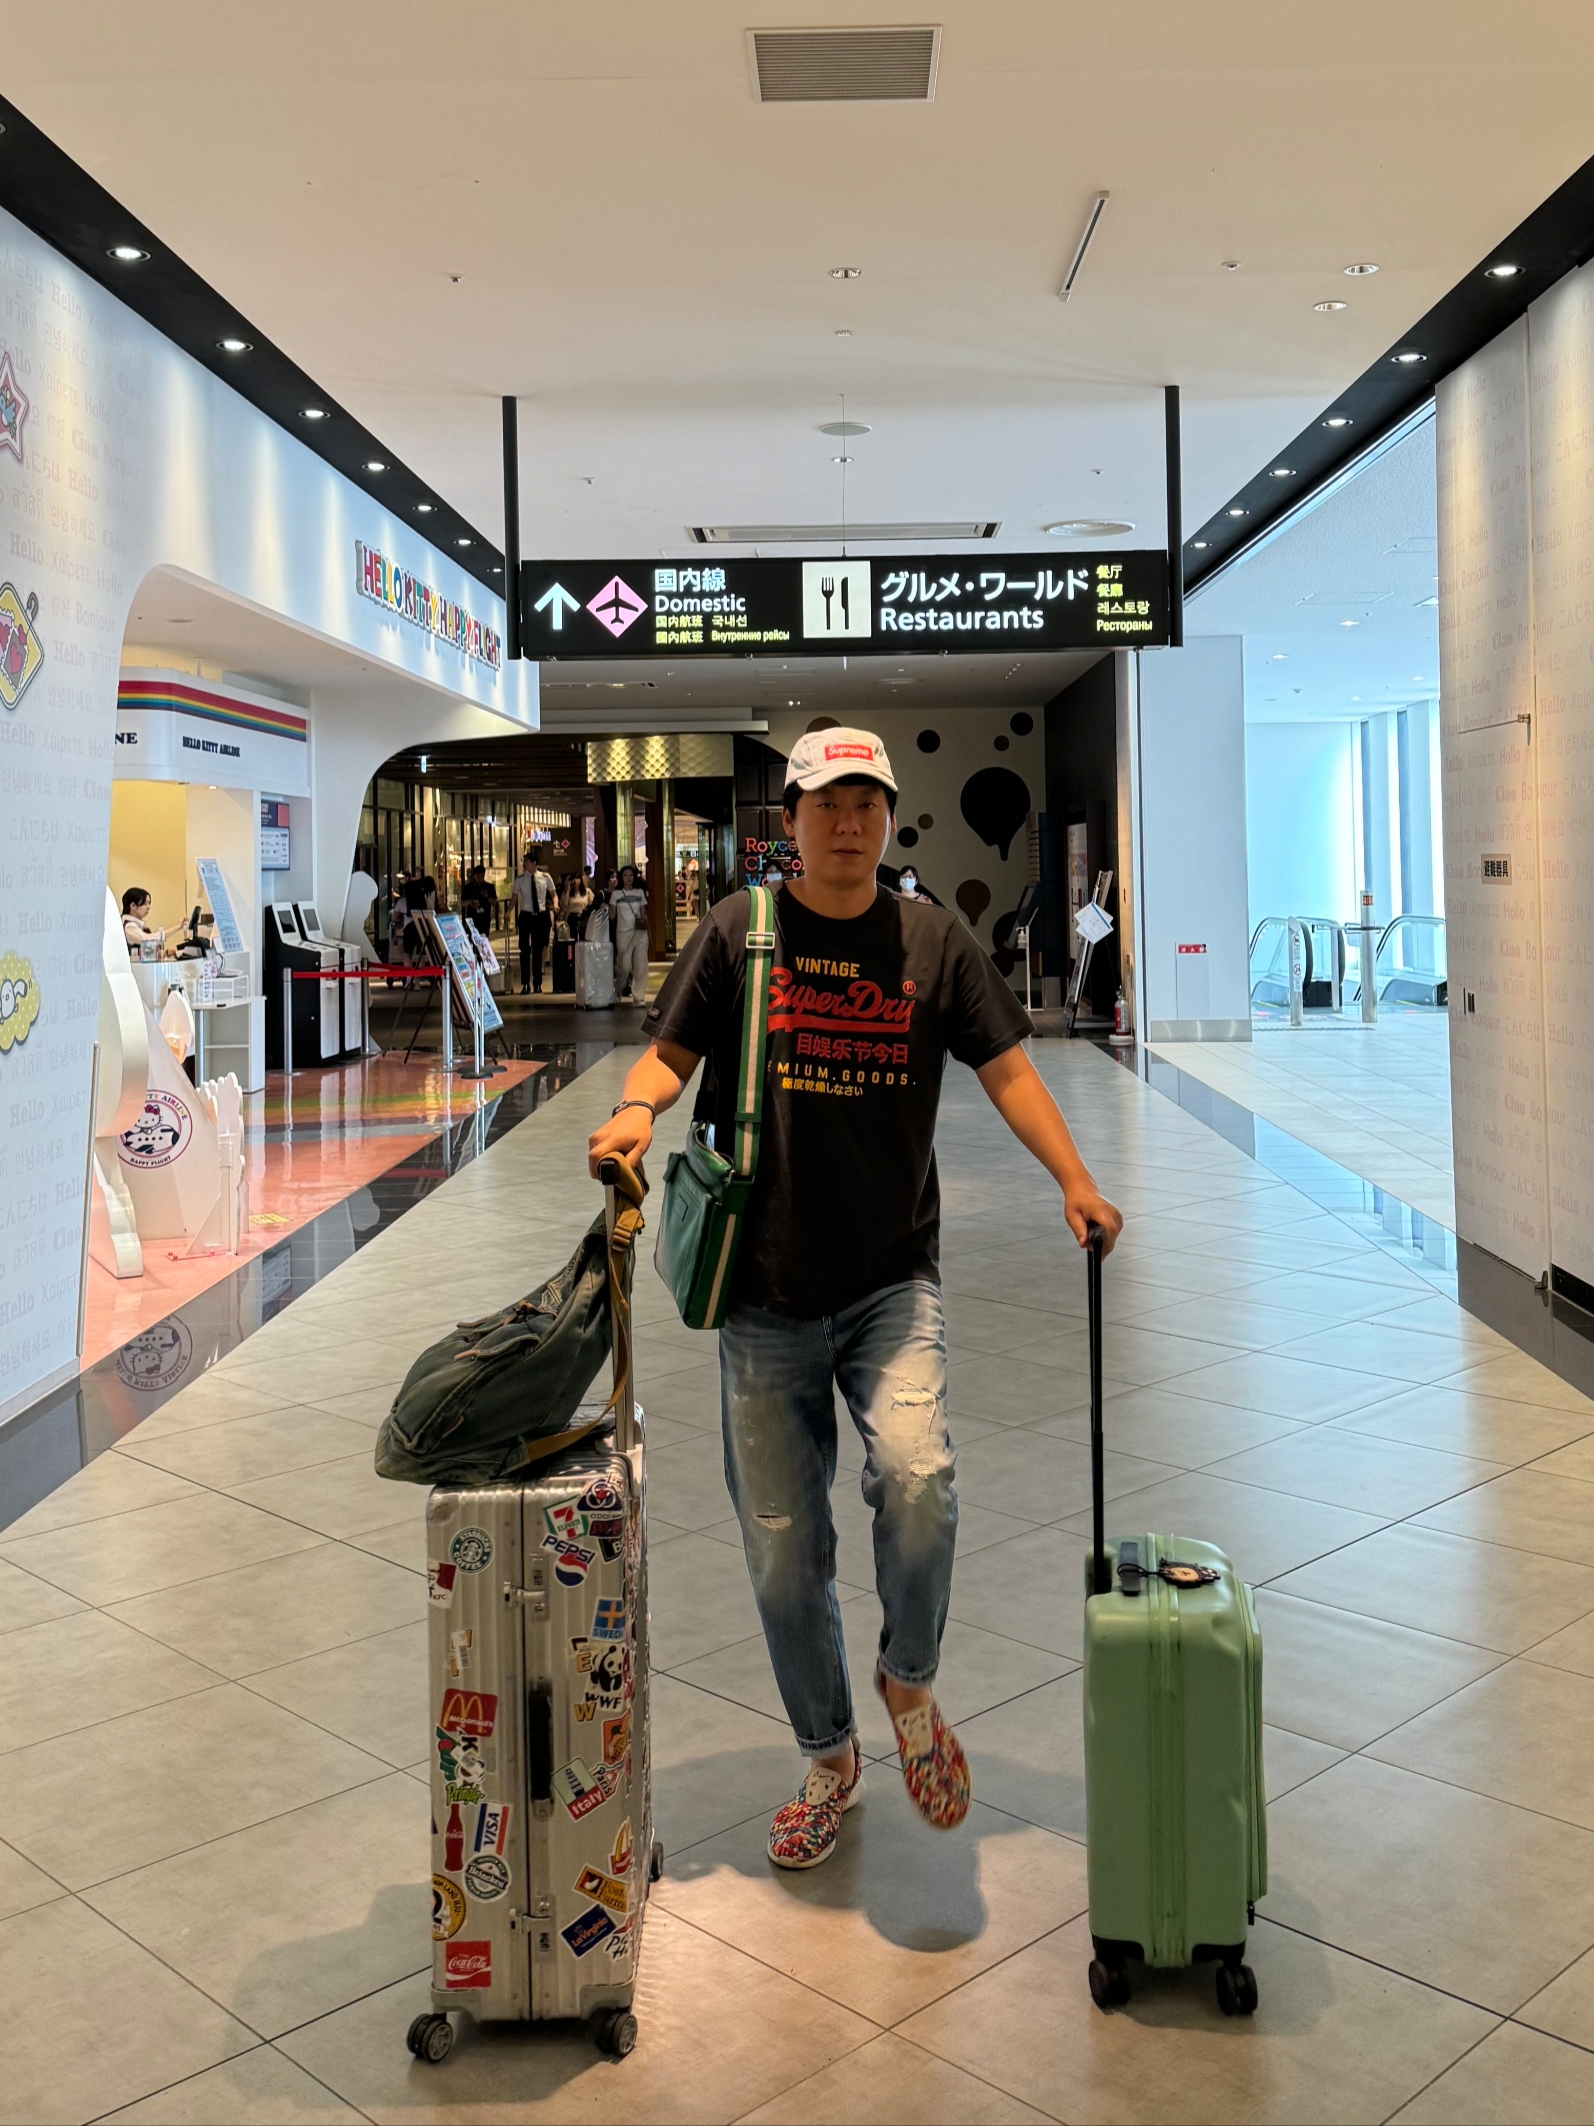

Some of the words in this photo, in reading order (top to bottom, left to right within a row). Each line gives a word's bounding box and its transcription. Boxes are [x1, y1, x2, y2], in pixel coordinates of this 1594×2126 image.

[71, 427, 99, 459] Ciao
[68, 468, 99, 501] Hello
[9, 531, 44, 566] Hello
[1537, 529, 1562, 555] Hello
[654, 568, 727, 592] 国内線
[1096, 565, 1123, 580] 餐厅
[881, 569, 1089, 603] グルメ・ワールド
[362, 545, 402, 608] HELLO
[403, 572, 438, 630] KITTY
[439, 596, 472, 650] HAPPY
[472, 620, 501, 668] FLIGHT
[655, 594, 746, 613] Domestic
[1096, 601, 1150, 615] 레스토랑
[711, 614, 748, 628] 국내선
[881, 607, 1044, 631] Restaurants
[1096, 618, 1153, 632] Рестораны
[762, 629, 790, 643] рейсы
[53, 639, 85, 668] Hello
[1540, 694, 1566, 718] Hello
[182, 736, 201, 750] HELLO
[202, 741, 219, 754] KITTY
[219, 746, 241, 758] AIRLINE
[828, 746, 869, 756] Supreme
[1543, 860, 1569, 880] Hello
[18, 911, 52, 934] Hello
[796, 956, 860, 978] VINTAGE
[66, 997, 98, 1021] Hello
[1548, 1022, 1574, 1047] Hello
[9, 1098, 44, 1127] Hello
[1553, 1186, 1579, 1216] Hello
[557, 1519, 581, 1533] ELEVEN
[454, 1551, 482, 1570] COFFEE
[542, 1535, 596, 1564] PEPSI
[592, 1767, 611, 1794] Paris
[572, 1790, 603, 1815] Italy
[484, 1812, 500, 1847] VISA
[468, 1866, 505, 1888] Heineken
[448, 1954, 487, 1970] Coca-Cola
